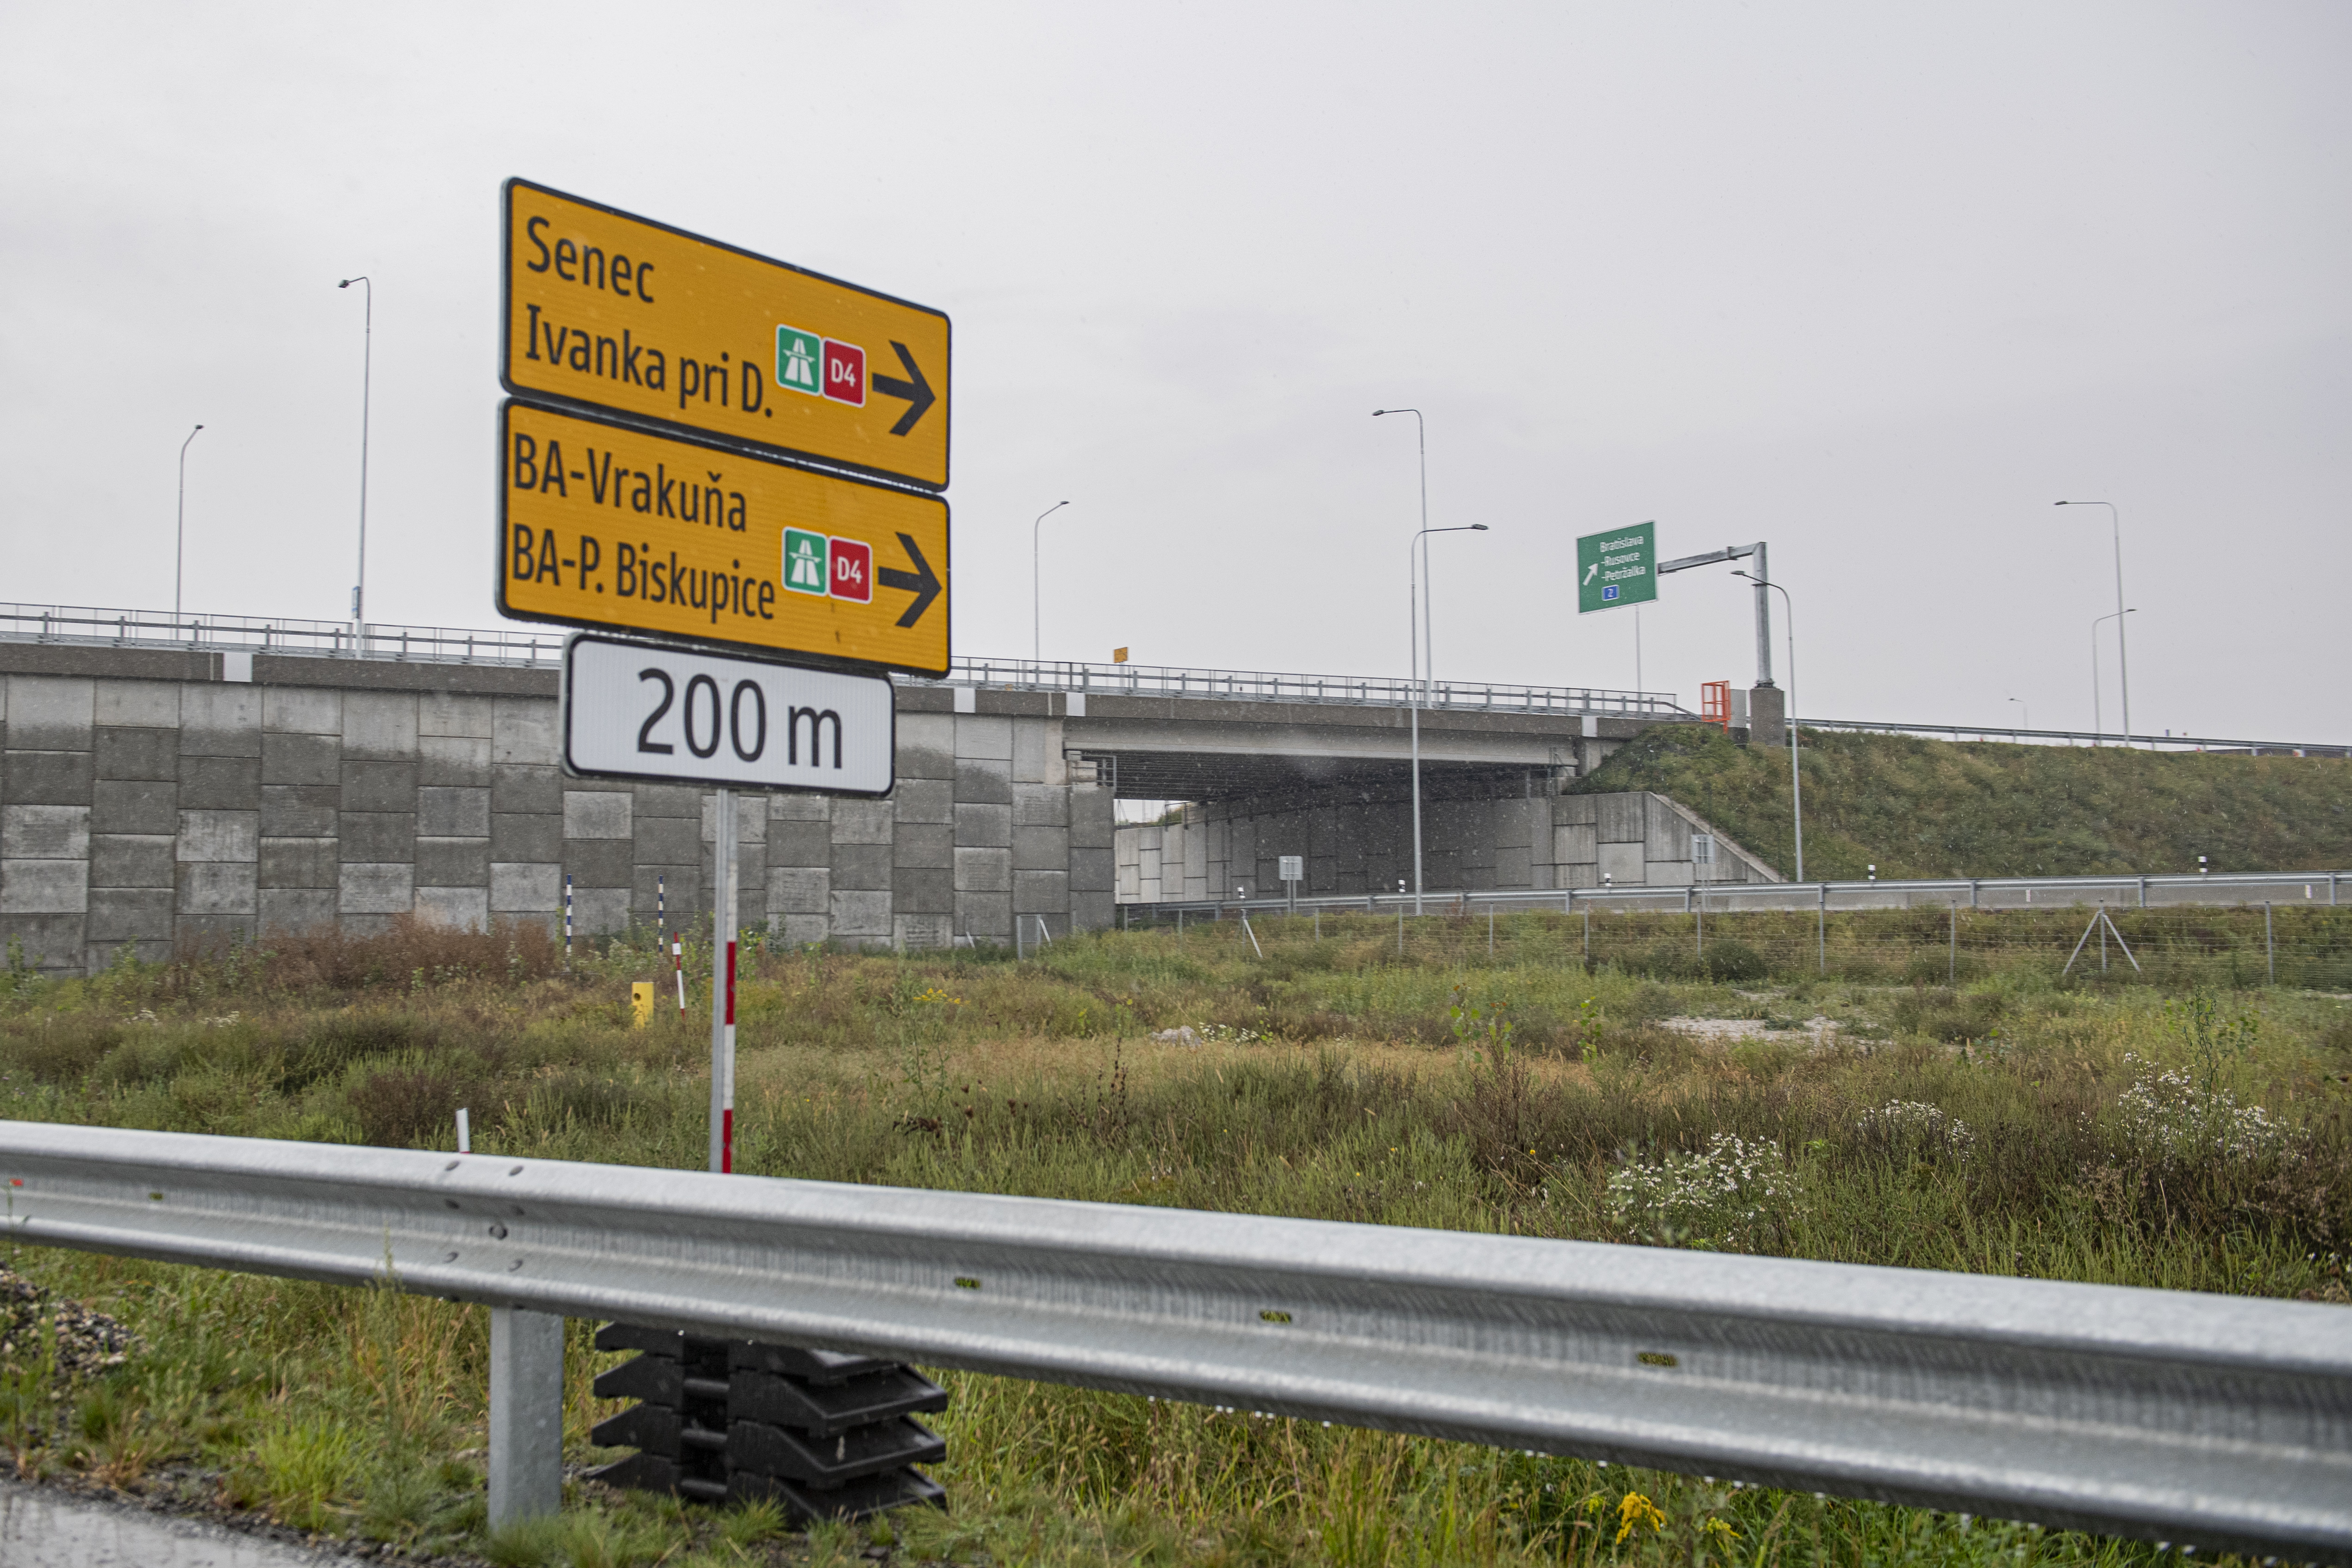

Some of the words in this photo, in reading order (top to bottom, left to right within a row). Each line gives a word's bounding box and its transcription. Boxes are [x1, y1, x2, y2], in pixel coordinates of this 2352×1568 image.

[526, 216, 655, 304] Senec
[525, 304, 666, 392] Ivanka
[679, 352, 729, 410] pri
[741, 361, 773, 418] D.
[830, 358, 856, 387] D4
[514, 432, 747, 532] BA-Vrakuňa
[512, 522, 604, 593] BA-P.
[617, 541, 775, 624] Biskupice
[837, 555, 862, 585] D4
[1600, 536, 1644, 552] Bratislava
[1608, 588, 1614, 598] 2
[637, 667, 767, 762] 200
[787, 705, 842, 769] m
